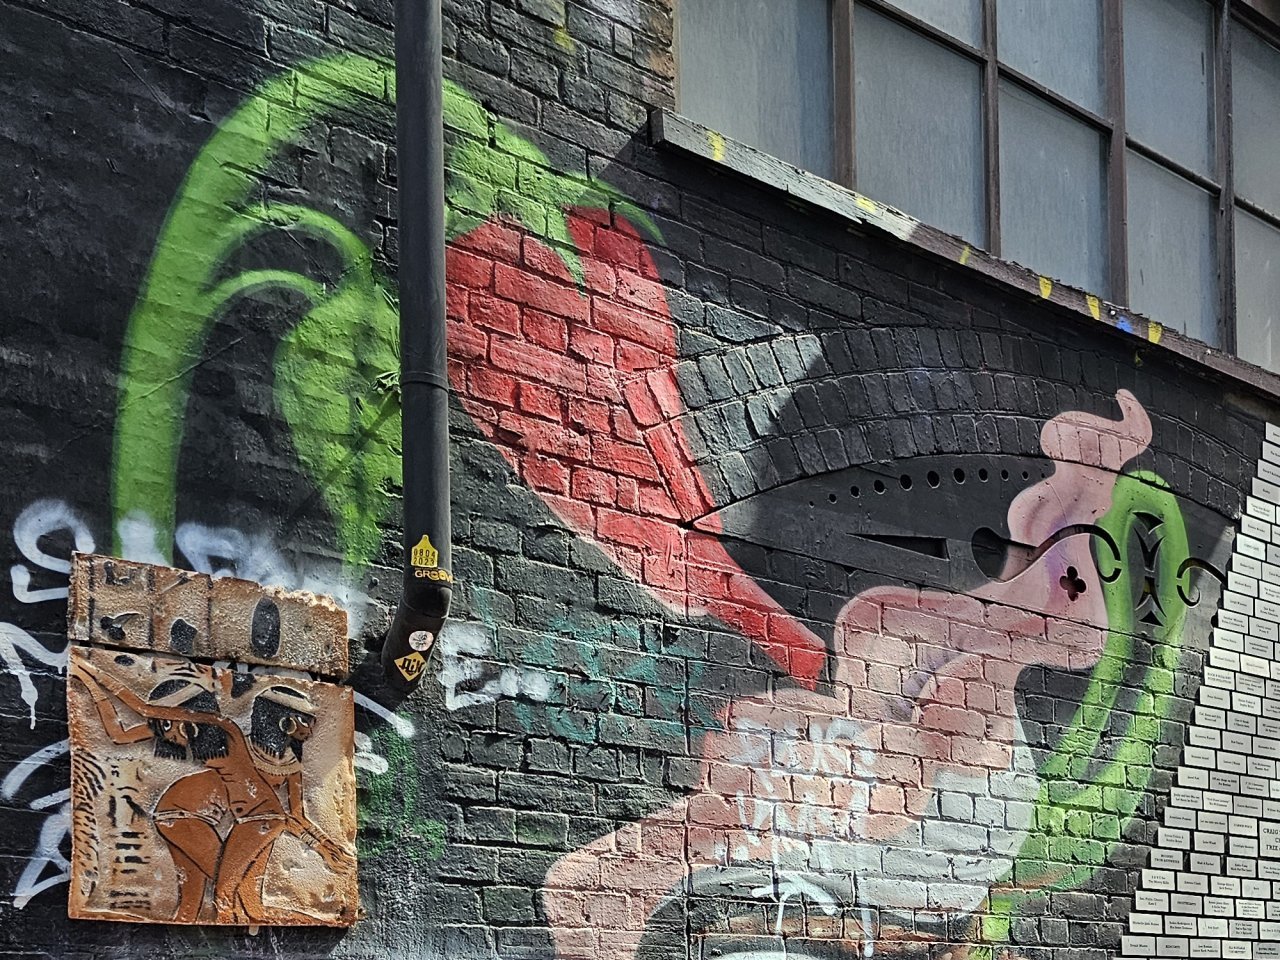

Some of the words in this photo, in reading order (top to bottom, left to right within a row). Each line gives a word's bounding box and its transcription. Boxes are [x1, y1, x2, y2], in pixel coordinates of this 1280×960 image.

[413, 549, 436, 559] 0804
[413, 557, 436, 567] 2023
[1263, 828, 1279, 836] CRAIG
